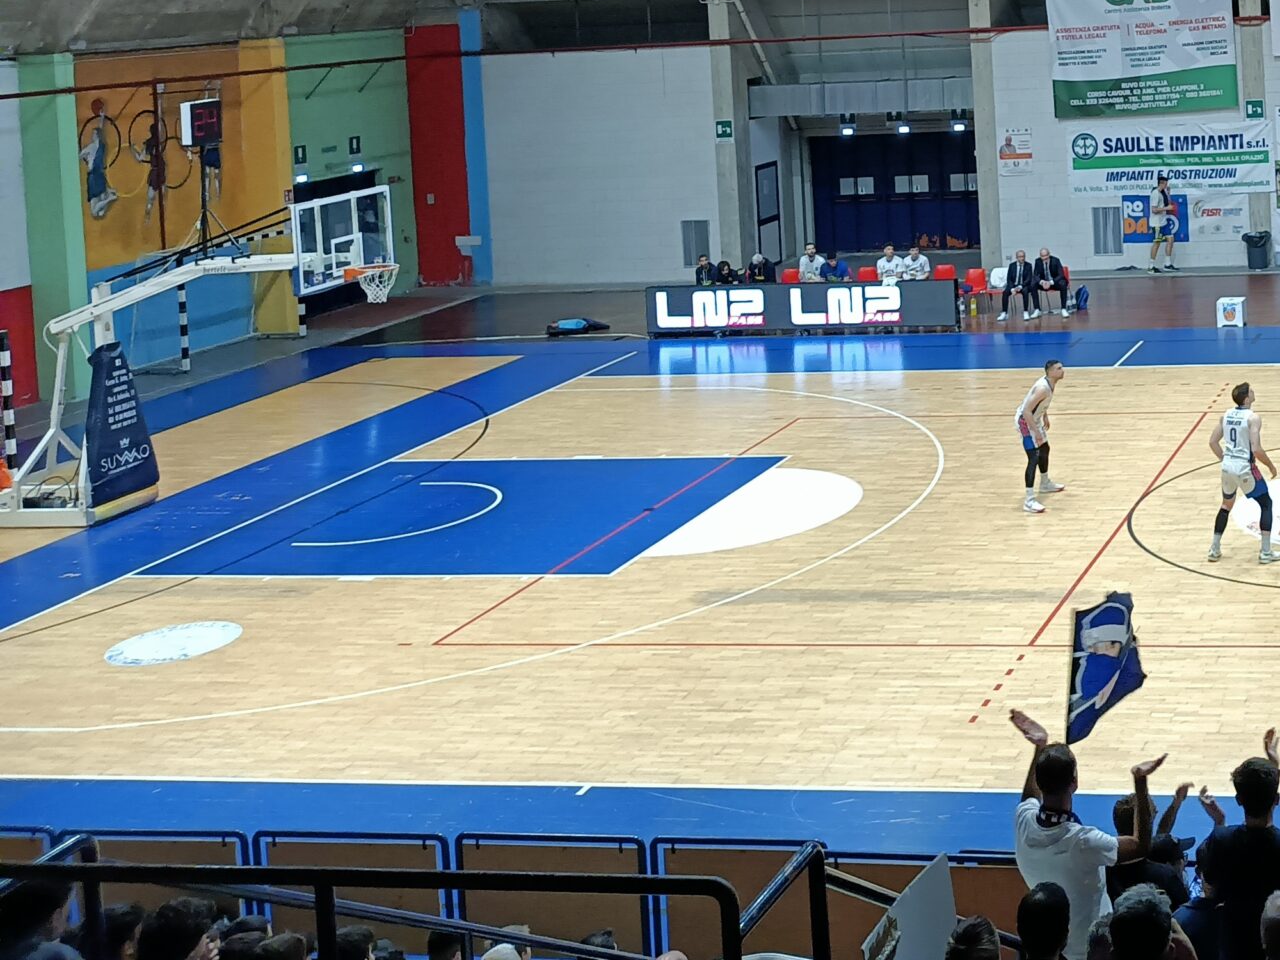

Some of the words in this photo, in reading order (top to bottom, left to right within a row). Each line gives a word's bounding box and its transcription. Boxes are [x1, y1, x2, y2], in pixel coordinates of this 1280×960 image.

[1056, 26, 1091, 34] ASSISTENZA
[1092, 24, 1121, 32] GRATUITA
[1194, 16, 1226, 24] ELETTRICA
[1135, 28, 1168, 36] TELEFONIA
[194, 109, 217, 136] 24
[1103, 137, 1164, 154] SAULLE
[1169, 134, 1244, 153] IMPIANTI
[1246, 139, 1269, 149] s.r.l.
[1106, 170, 1154, 182] IMPIANTI
[1167, 168, 1237, 180] COSTRUZIONI
[1123, 201, 1144, 218] RO
[655, 289, 764, 328] LNP
[789, 286, 901, 325] LNP
[728, 315, 764, 325] PASS
[864, 312, 900, 323] PASS
[1229, 427, 1237, 448] 9
